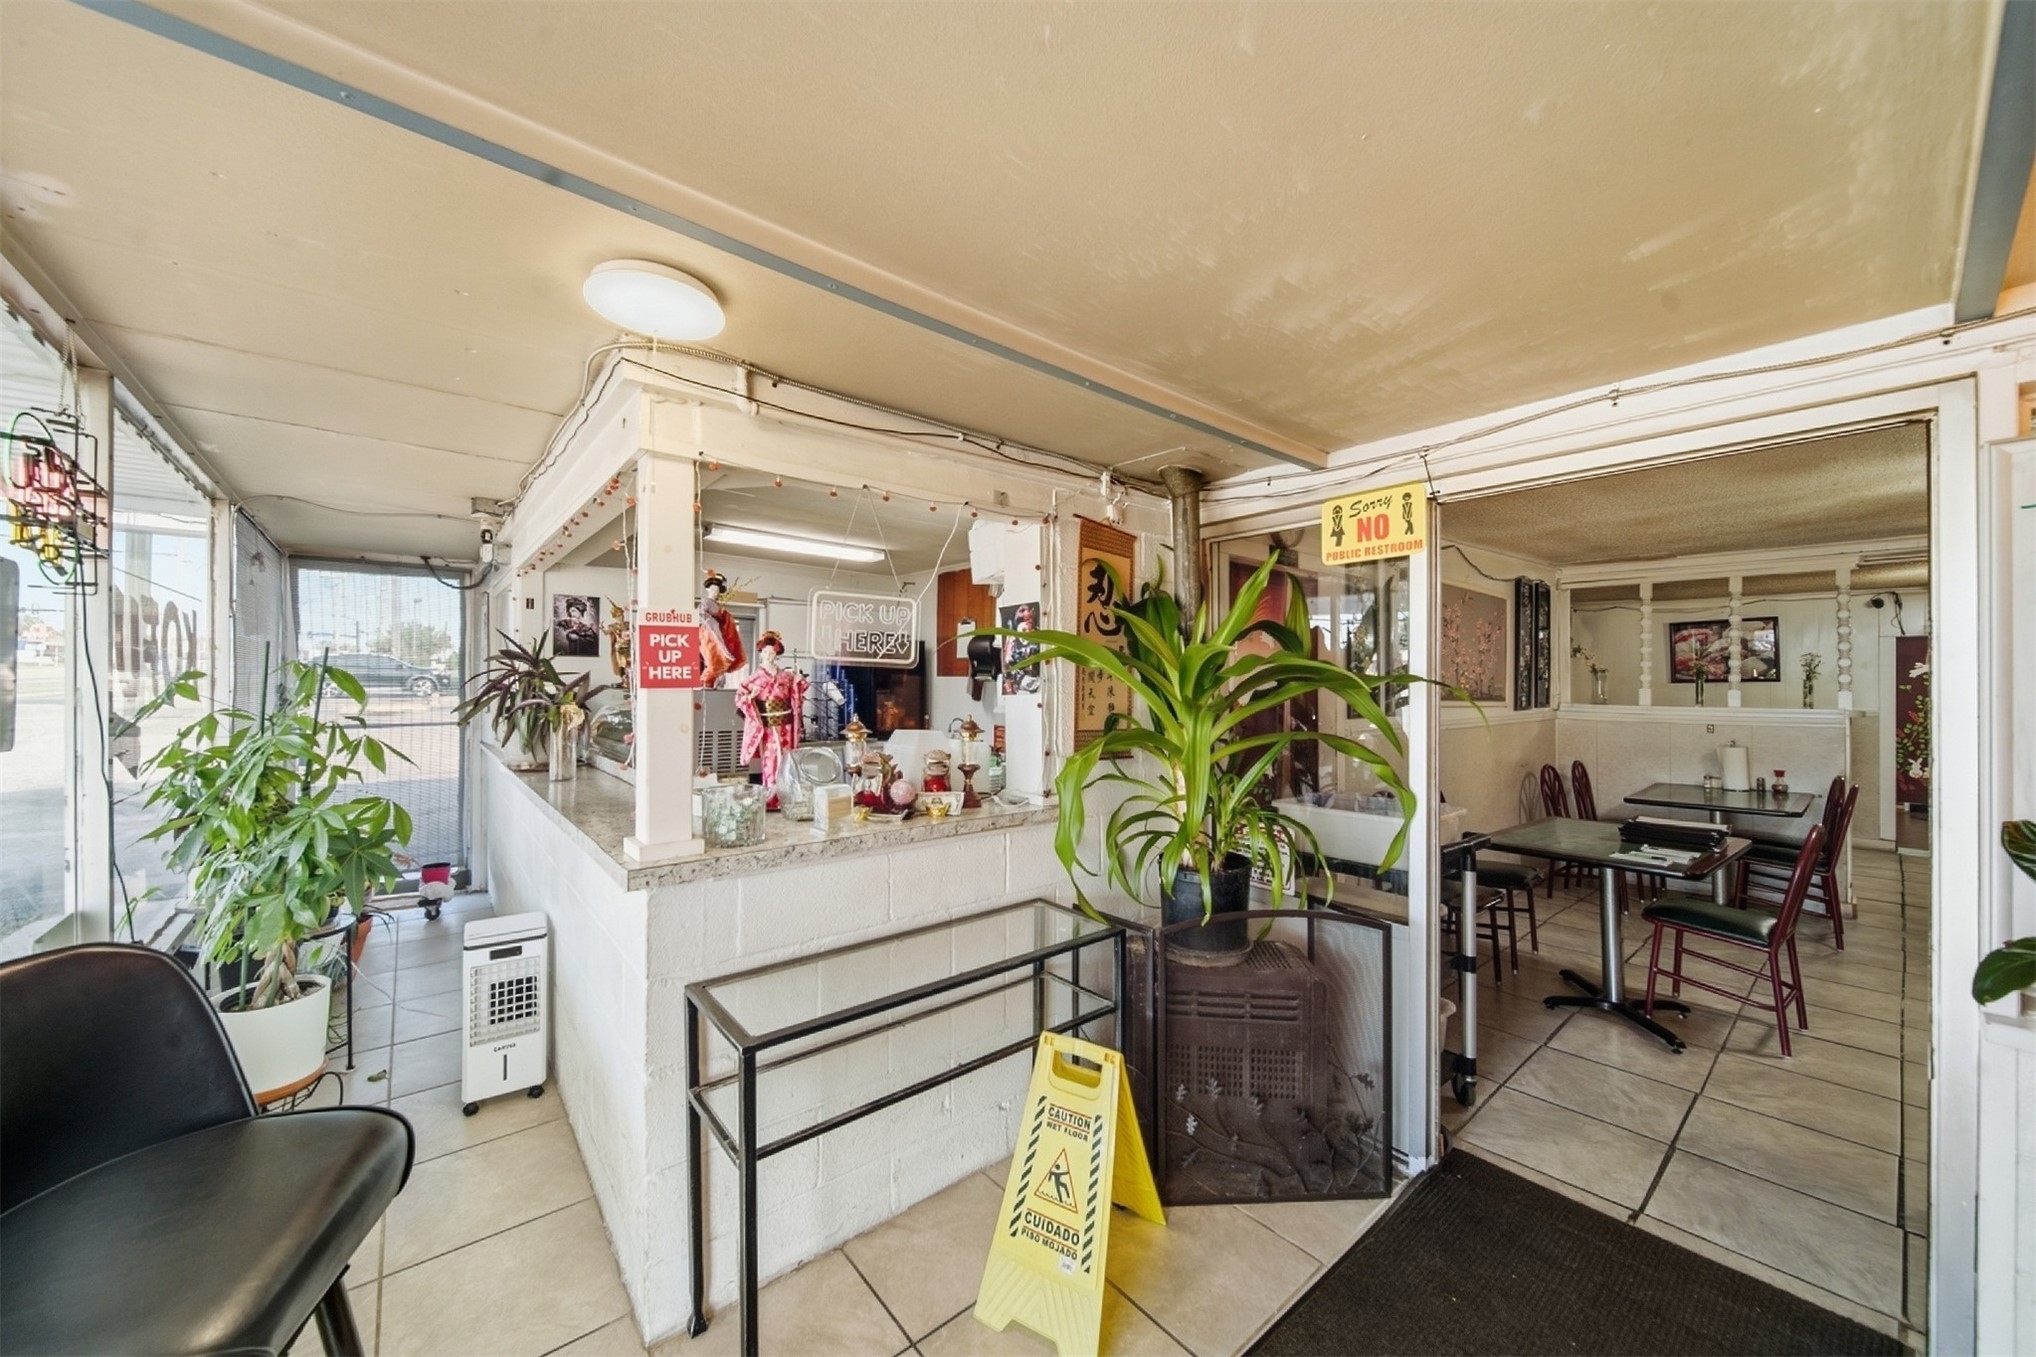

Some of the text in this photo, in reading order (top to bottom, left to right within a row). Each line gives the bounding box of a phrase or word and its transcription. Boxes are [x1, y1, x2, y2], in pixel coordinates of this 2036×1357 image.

[1349, 495, 1392, 518] Sorry
[1357, 513, 1390, 543] NO
[1326, 539, 1423, 562] PUBLIC RESTROOM
[645, 611, 693, 623] GRUBHUB
[820, 600, 911, 626] PICK UP
[649, 633, 690, 648] PICK
[836, 628, 896, 654] HERE
[658, 650, 682, 663] UP
[648, 666, 692, 679] HERE
[1048, 1106, 1091, 1131] CAUTION
[1046, 1121, 1089, 1142] WET FLOOR
[1024, 1211, 1080, 1246] CUIDADO
[1021, 1227, 1078, 1261] PISO MOJADO
